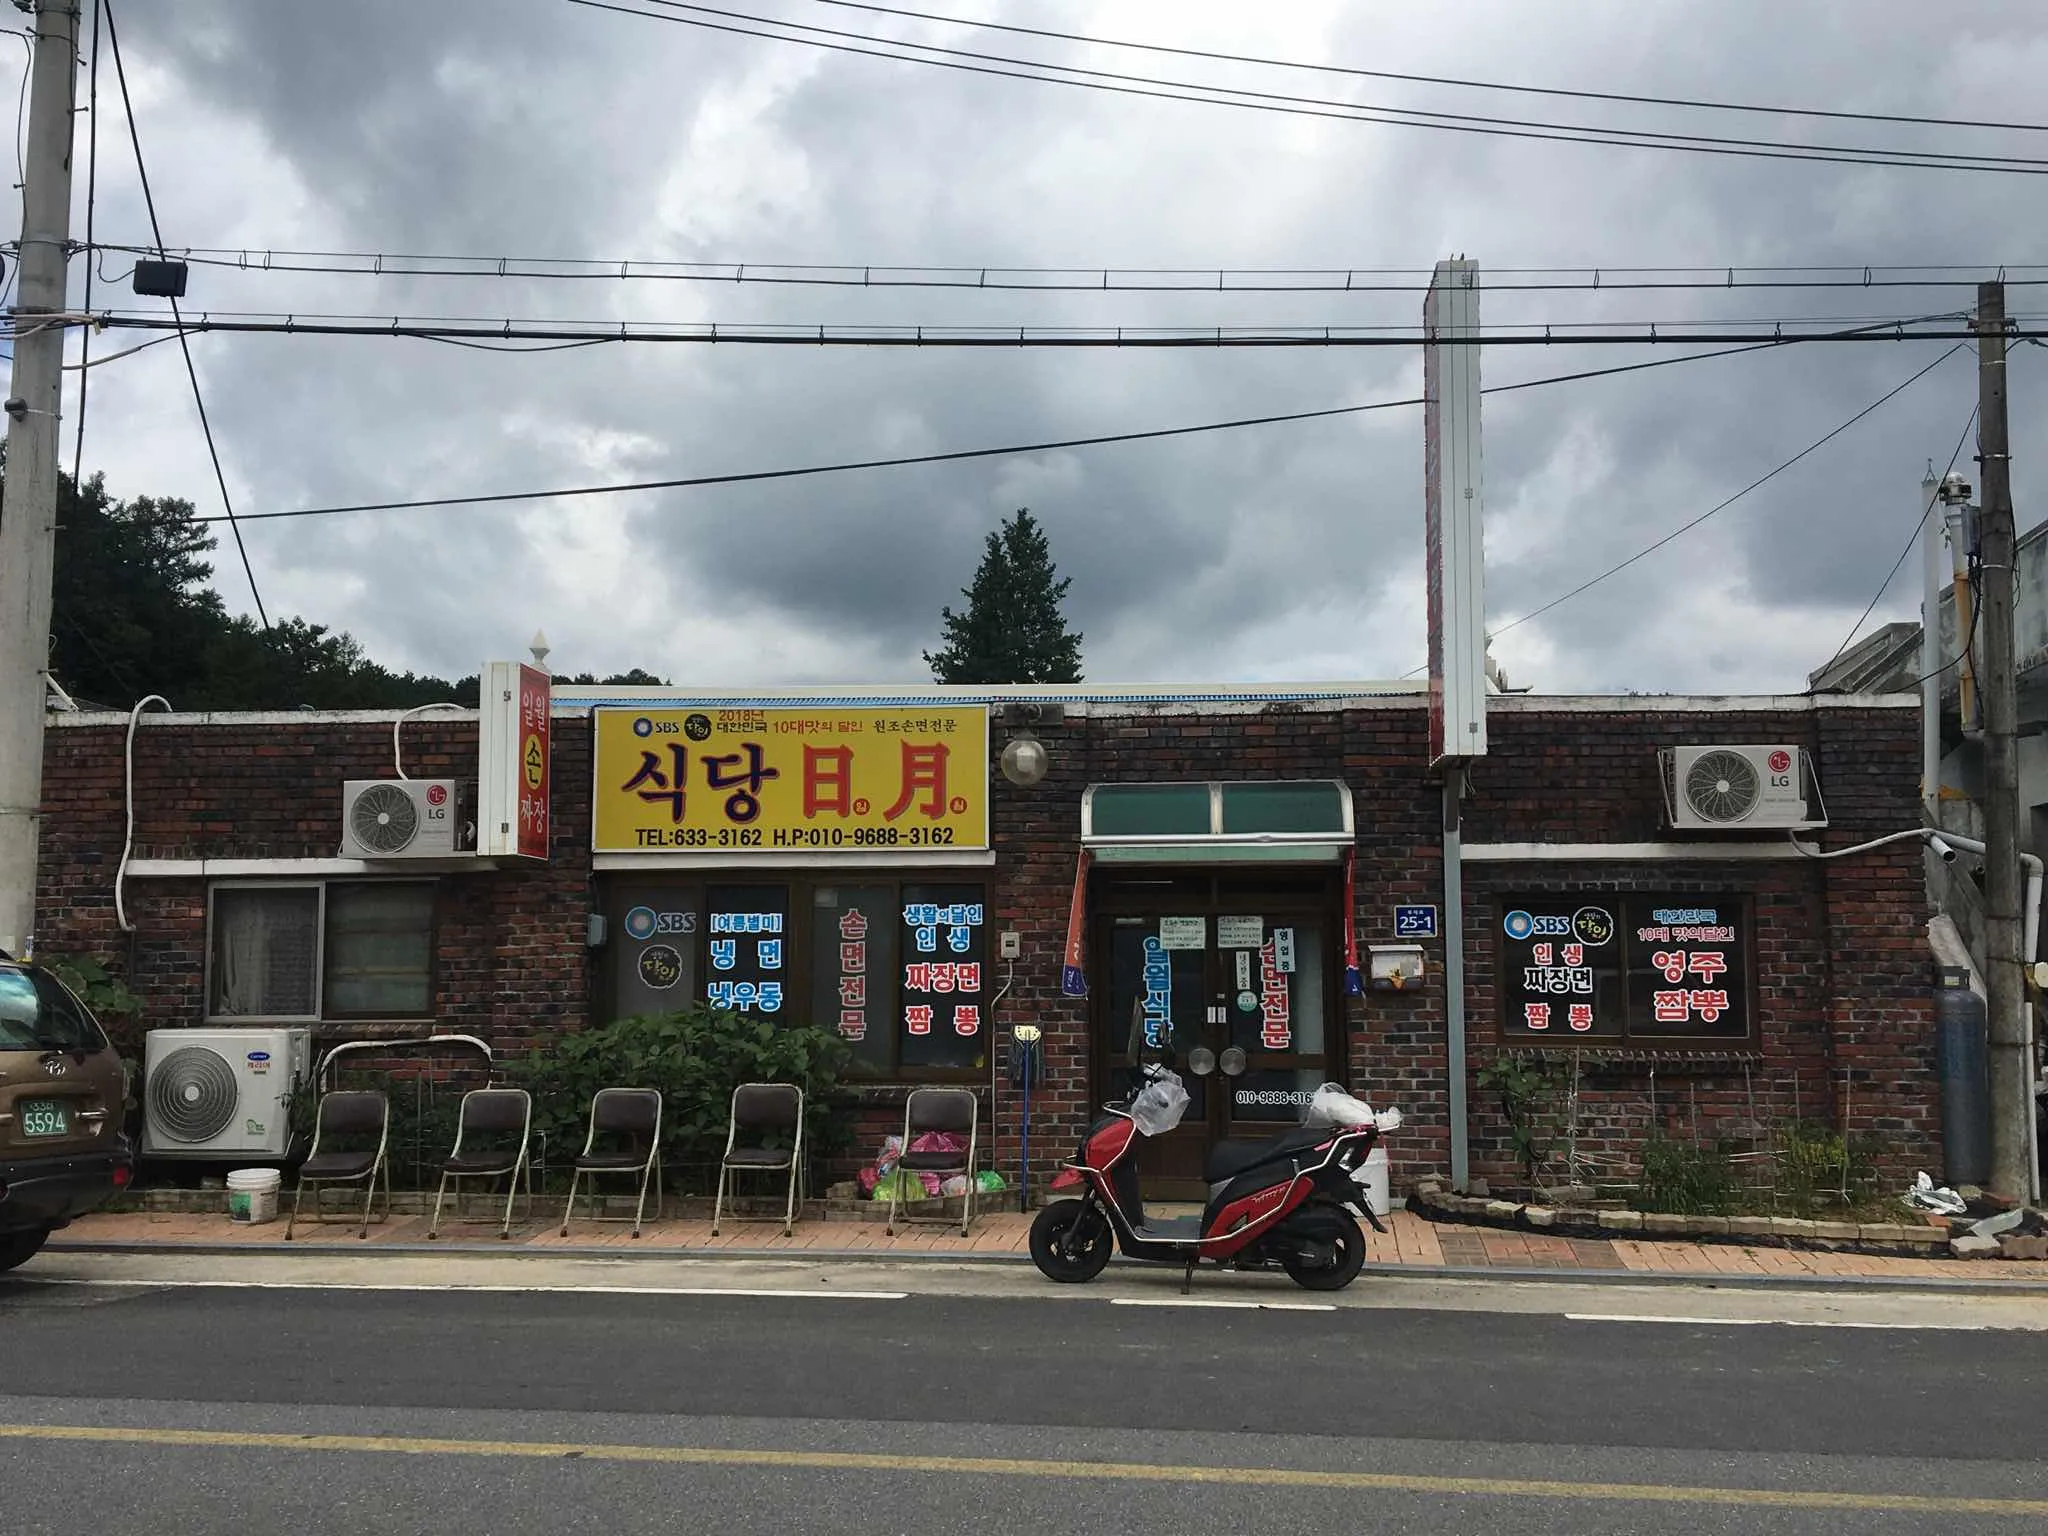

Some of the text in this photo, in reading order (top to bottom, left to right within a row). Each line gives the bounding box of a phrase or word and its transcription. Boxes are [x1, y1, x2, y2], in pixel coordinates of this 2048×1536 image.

[655, 722, 679, 733] SBS
[717, 721, 767, 733] 대한민국
[838, 721, 863, 732] 달인
[872, 719, 957, 733] 원조손면전문
[621, 742, 780, 824] 식당
[803, 743, 854, 819] 日
[883, 738, 950, 822] 月
[1771, 776, 1789, 787] LG
[428, 809, 445, 819] LG
[636, 829, 762, 846] TEL:633-3162
[658, 913, 696, 932] SBS
[1400, 916, 1431, 929] 25-1
[1533, 916, 1569, 935] SBS
[1653, 909, 1717, 924] 대한민국
[1637, 927, 1669, 942] 10대
[839, 908, 867, 1041] 손면전문
[1652, 950, 1727, 983] 영주
[905, 962, 981, 993] 짜장면
[1523, 967, 1593, 993] 짜장면
[708, 982, 783, 1012] 냉우동
[1654, 989, 1729, 1022] 짬뽕
[1236, 1091, 1314, 1105] 010-9688-316
[25, 1112, 65, 1132] 5594
